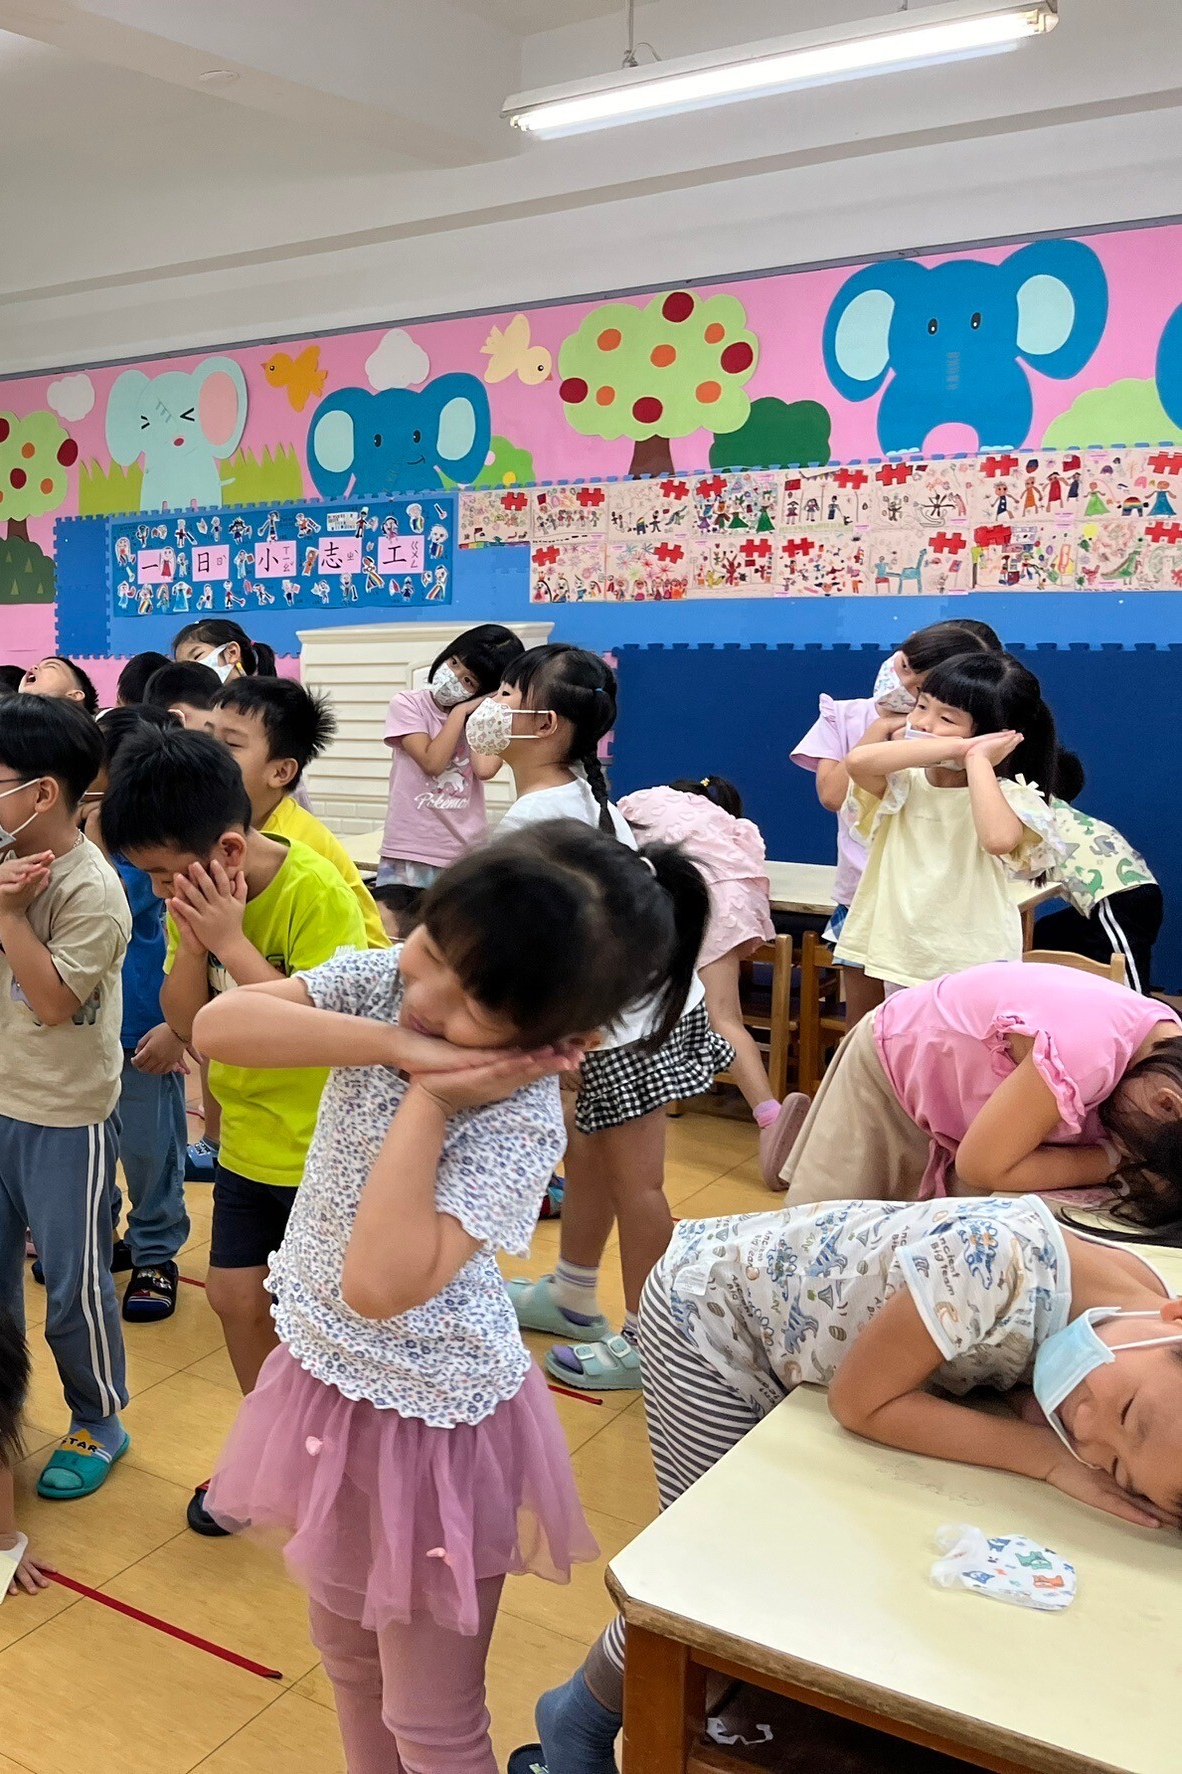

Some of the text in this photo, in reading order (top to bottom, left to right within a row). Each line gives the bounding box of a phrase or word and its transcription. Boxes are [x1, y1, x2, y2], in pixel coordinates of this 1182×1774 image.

[197, 551, 210, 573] 日
[258, 547, 279, 573] 小
[321, 541, 343, 570] 志
[382, 545, 407, 565] 工
[930, 1242, 956, 1297] Big team
